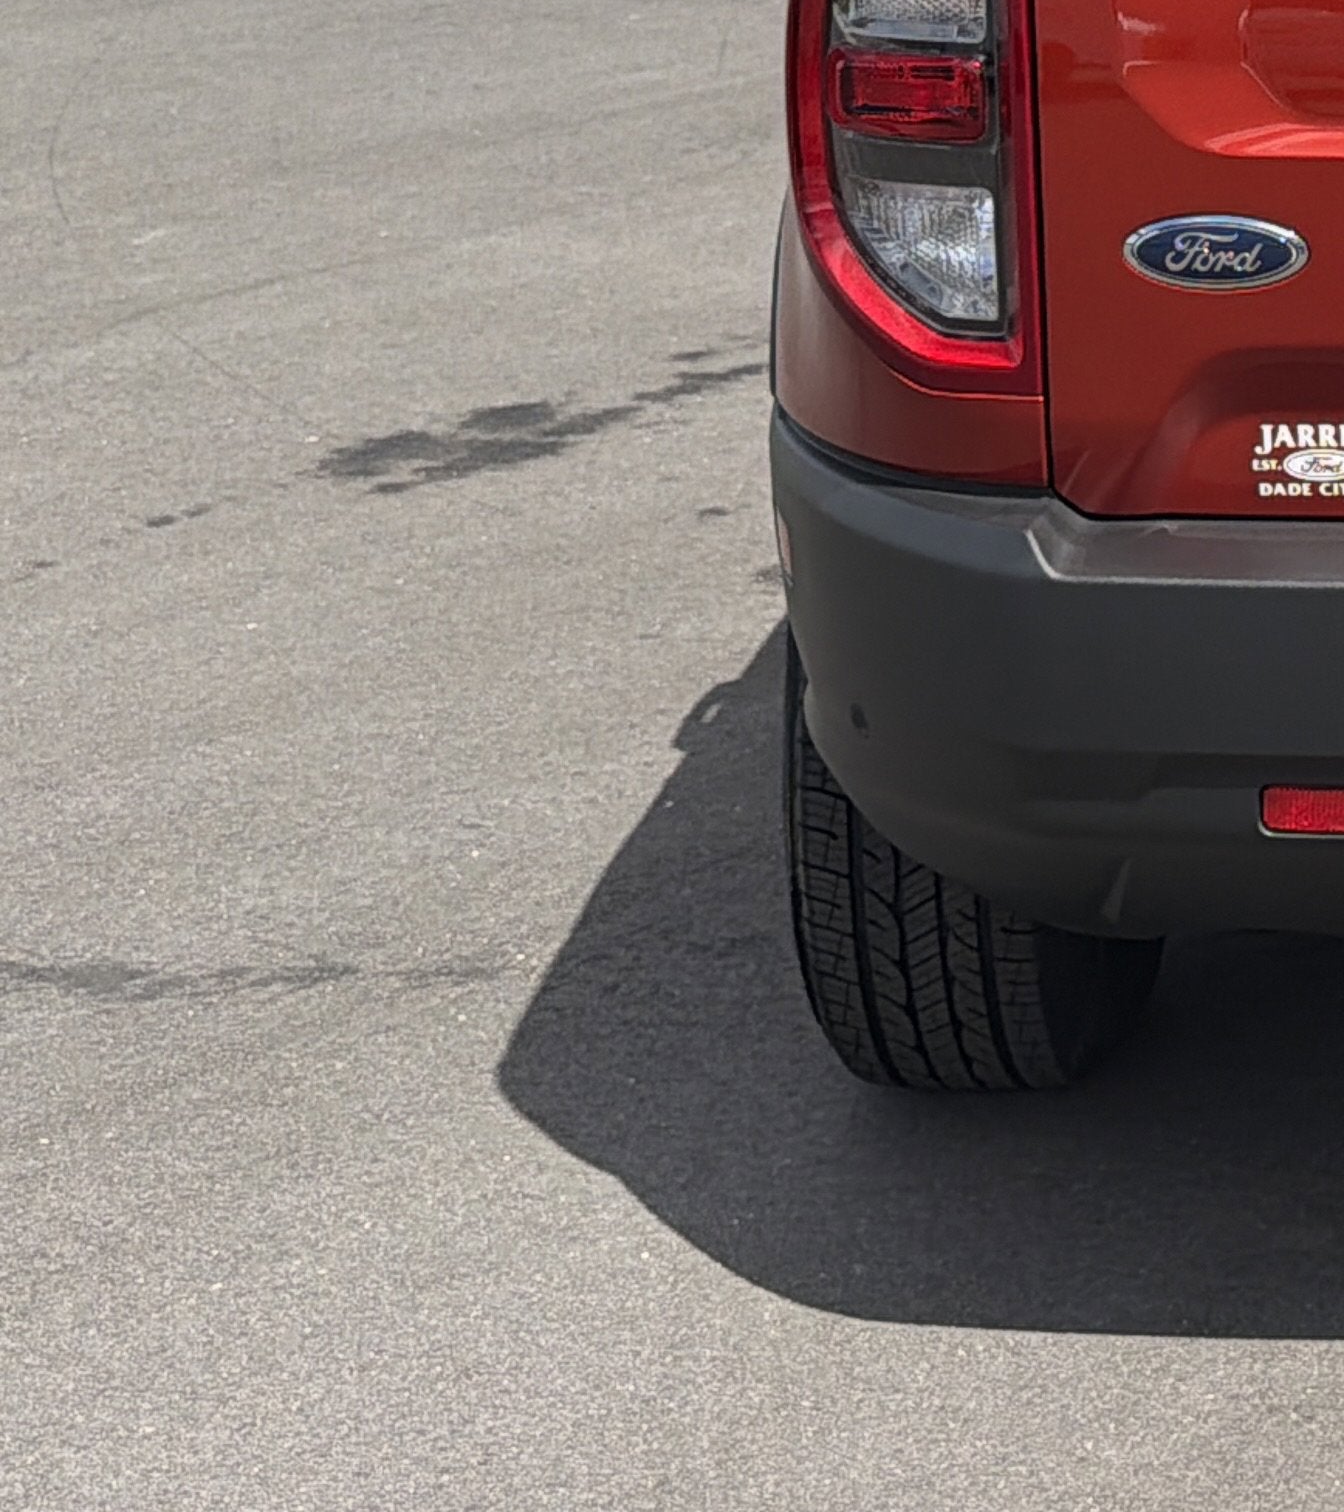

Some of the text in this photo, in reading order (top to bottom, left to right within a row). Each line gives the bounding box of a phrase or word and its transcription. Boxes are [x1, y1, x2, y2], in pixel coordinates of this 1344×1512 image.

[1164, 230, 1263, 273] Ford
[1251, 458, 1283, 471] EST.
[1299, 456, 1344, 474] Ford
[1258, 482, 1313, 496] DADE
